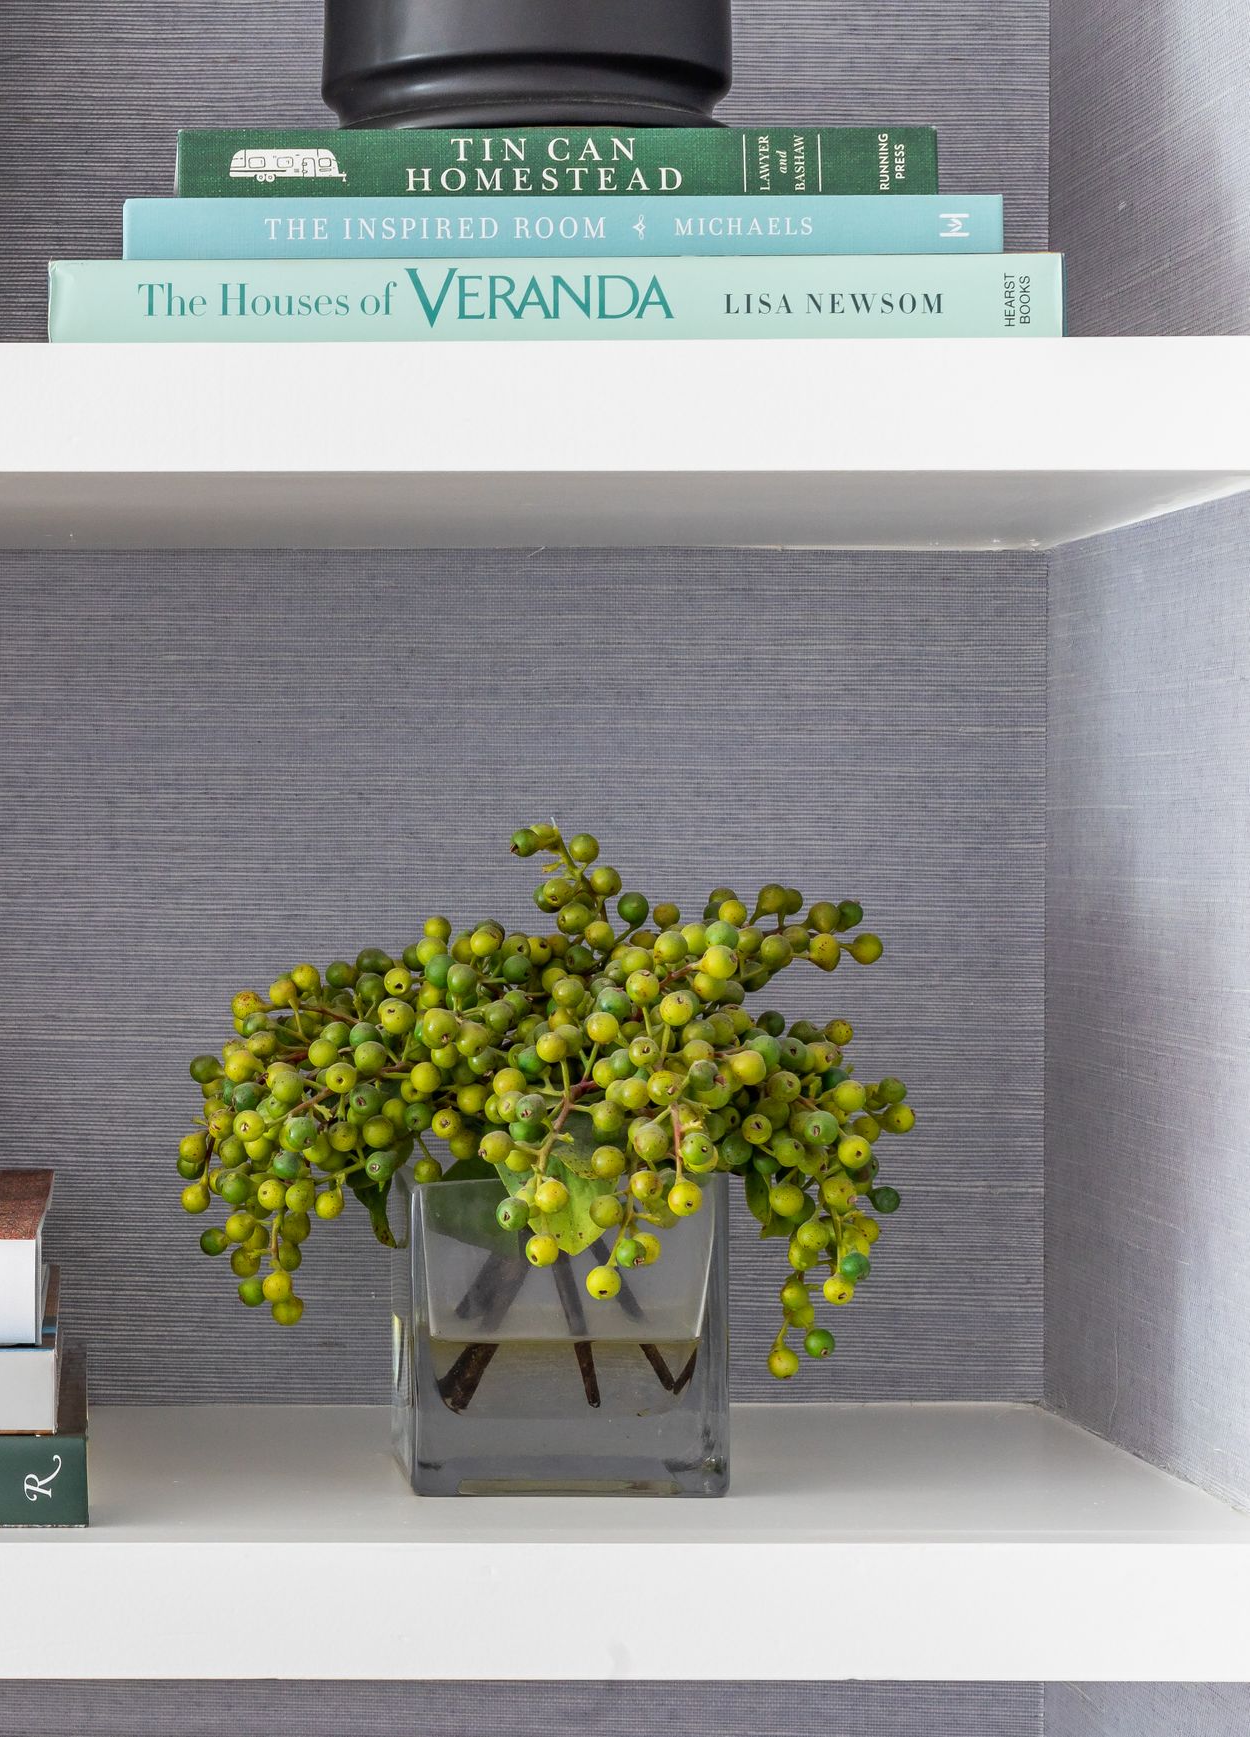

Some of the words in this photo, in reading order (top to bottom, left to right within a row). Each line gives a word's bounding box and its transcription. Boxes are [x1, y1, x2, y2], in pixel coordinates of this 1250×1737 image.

[450, 137, 527, 162] TIN
[547, 137, 636, 162] CAN
[757, 135, 771, 191] LAWYER
[775, 150, 788, 174] and
[793, 134, 806, 191] BASHAW
[877, 133, 890, 190] RUNNING
[893, 143, 906, 179] PRESS
[405, 167, 683, 192] HOMESTEAD
[264, 217, 328, 240] THE
[343, 217, 499, 240] INSPIRED
[513, 216, 607, 241] ROOM
[674, 216, 813, 238] MICHAELS
[137, 282, 207, 317] The
[220, 283, 350, 317] Houses
[360, 281, 398, 316] of
[404, 267, 675, 329] VERANDA
[724, 293, 793, 315] LISA
[806, 292, 944, 314] NEWSOM
[1003, 272, 1016, 327] HEARST
[1018, 275, 1031, 325] BOOKS
